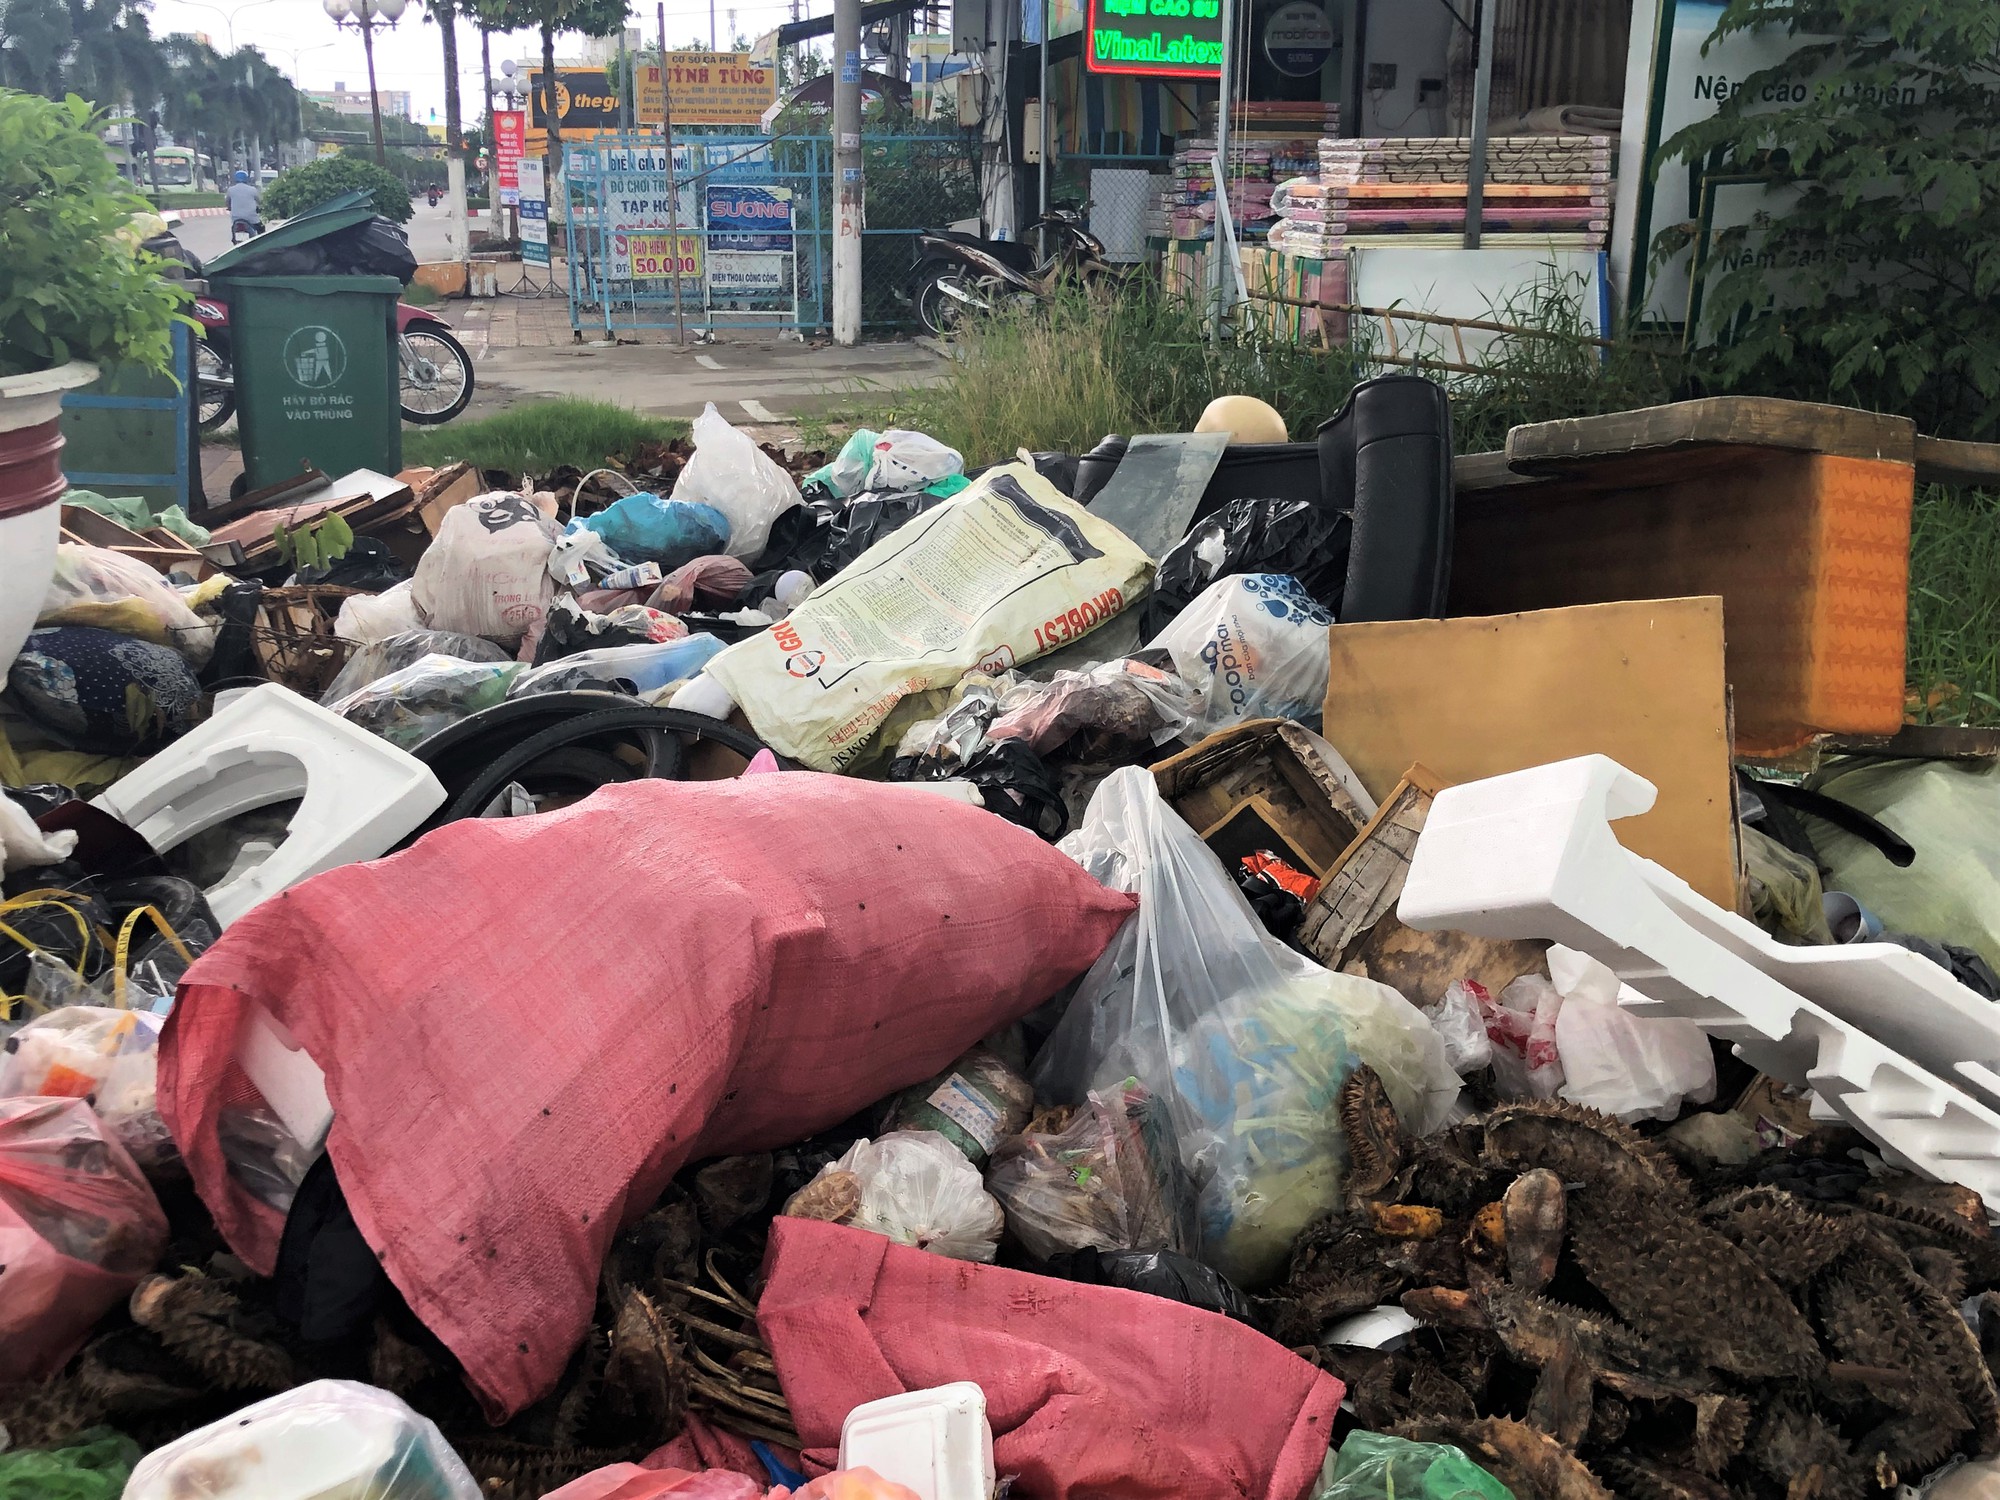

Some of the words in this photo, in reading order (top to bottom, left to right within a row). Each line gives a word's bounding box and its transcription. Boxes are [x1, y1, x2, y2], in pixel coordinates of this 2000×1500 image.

[1094, 29, 1223, 64] VinaLatex
[719, 66, 765, 84] TÙNG
[1761, 83, 1807, 103] cao
[620, 200, 649, 215] TẠP
[710, 200, 789, 219] SƯƠNG
[635, 257, 696, 274] 50.000
[1032, 586, 1126, 654] GROBEST
